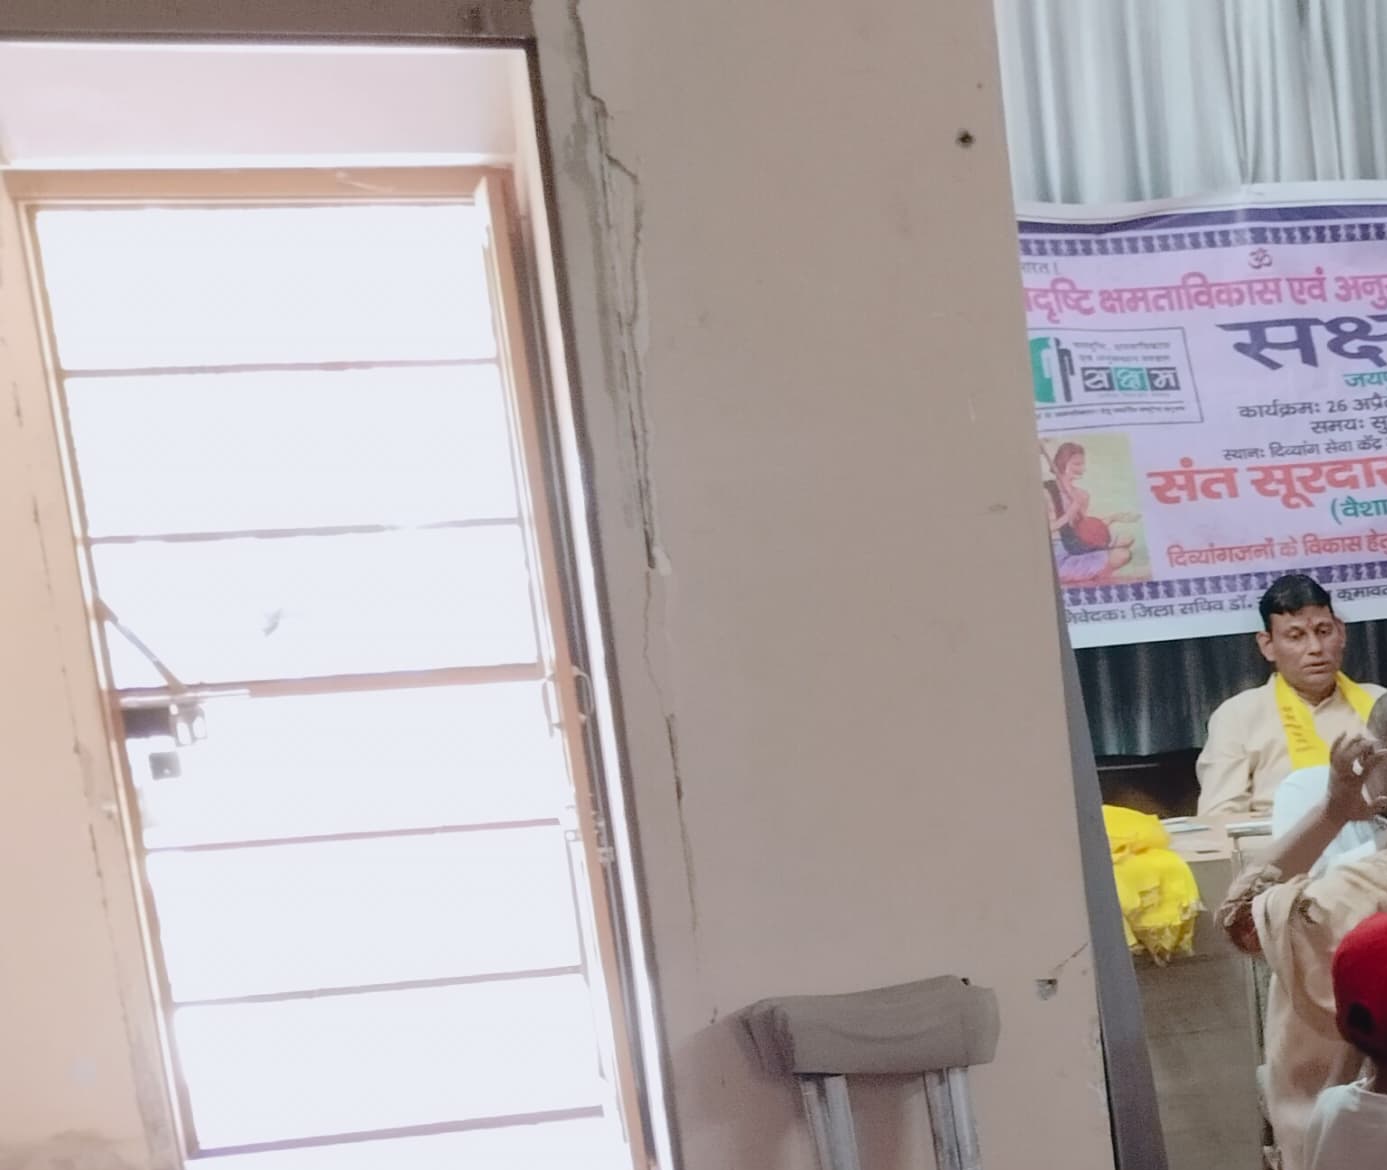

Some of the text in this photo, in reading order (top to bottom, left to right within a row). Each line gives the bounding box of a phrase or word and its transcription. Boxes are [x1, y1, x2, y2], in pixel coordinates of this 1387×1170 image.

[1024, 276, 1096, 324] दृष्टि
[1286, 267, 1329, 305] एवं
[1326, 399, 1348, 414] 26
[1325, 438, 1353, 454] सेवा
[1147, 456, 1239, 505] संत
[1276, 535, 1298, 557] के
[1302, 532, 1362, 557] विकास
[1131, 602, 1176, 620] जिला
[1180, 597, 1225, 615] सचिव
